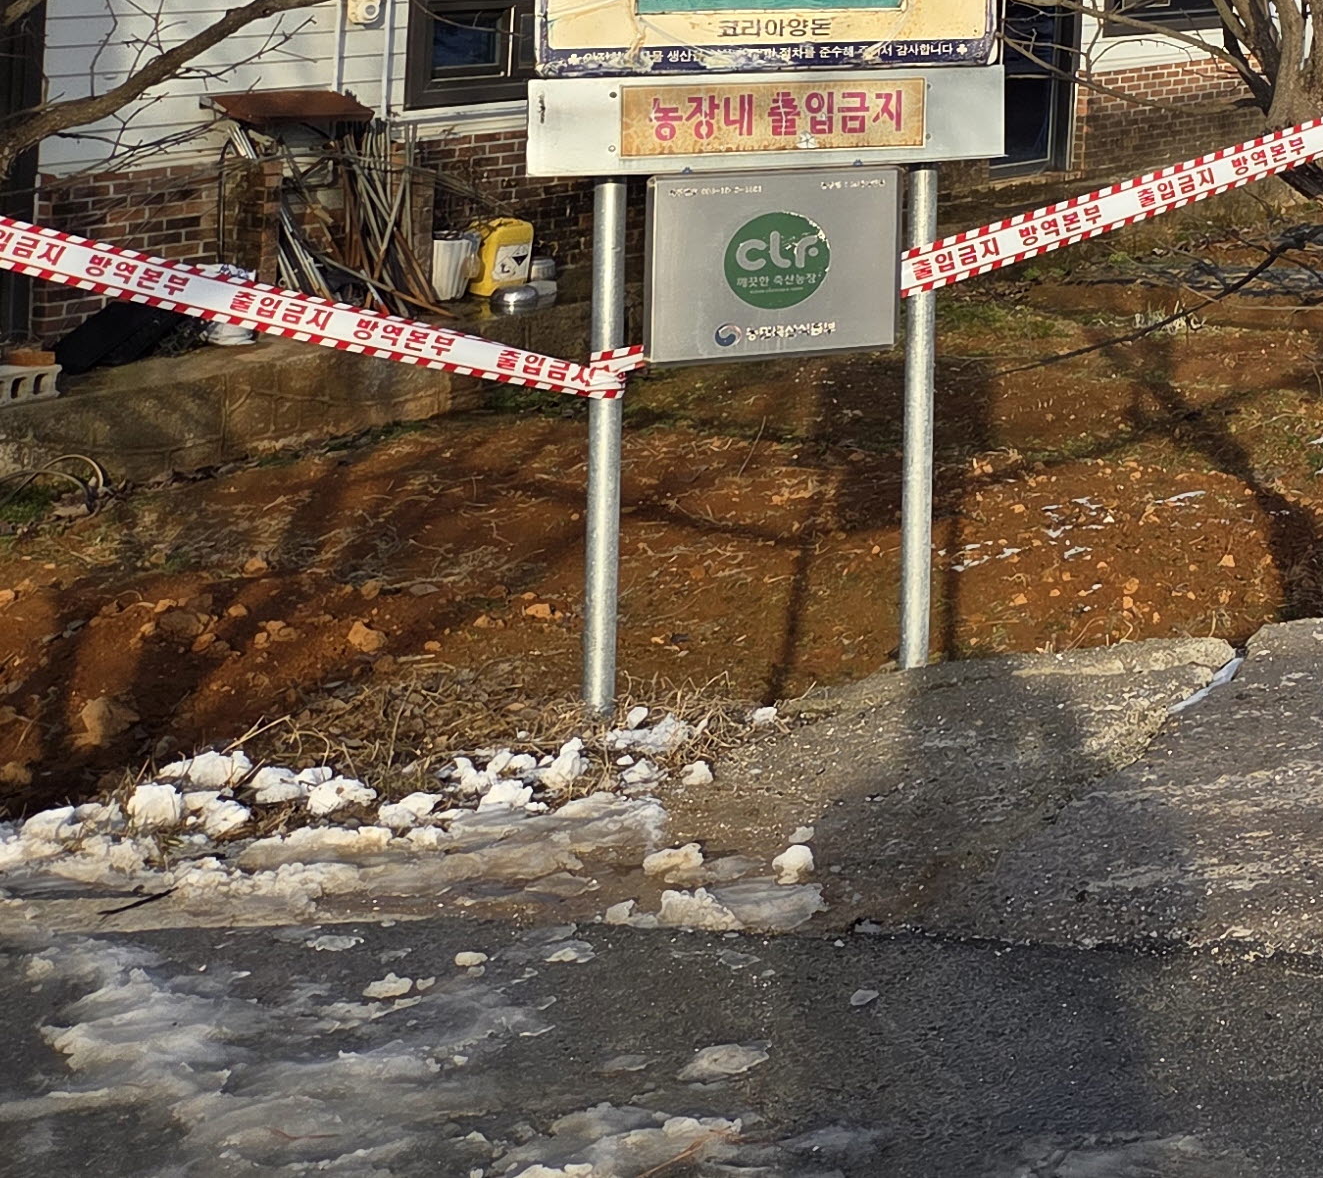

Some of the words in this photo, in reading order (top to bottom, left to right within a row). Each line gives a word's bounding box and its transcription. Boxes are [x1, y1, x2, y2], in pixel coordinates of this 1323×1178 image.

[718, 18, 832, 37] 코리아양돈
[819, 45, 855, 59] 준수해
[896, 43, 954, 57] 감사합니다
[649, 93, 754, 142] 농장내
[767, 90, 904, 137] 출입금지
[911, 239, 1000, 281] 출입금지
[1018, 203, 1103, 246] 방역본부
[1137, 168, 1216, 208] 출입금지
[1231, 136, 1306, 176] 방역본부
[85, 253, 191, 296] 방역본부
[229, 290, 334, 332] 출입금지
[353, 317, 456, 357] 방역본부
